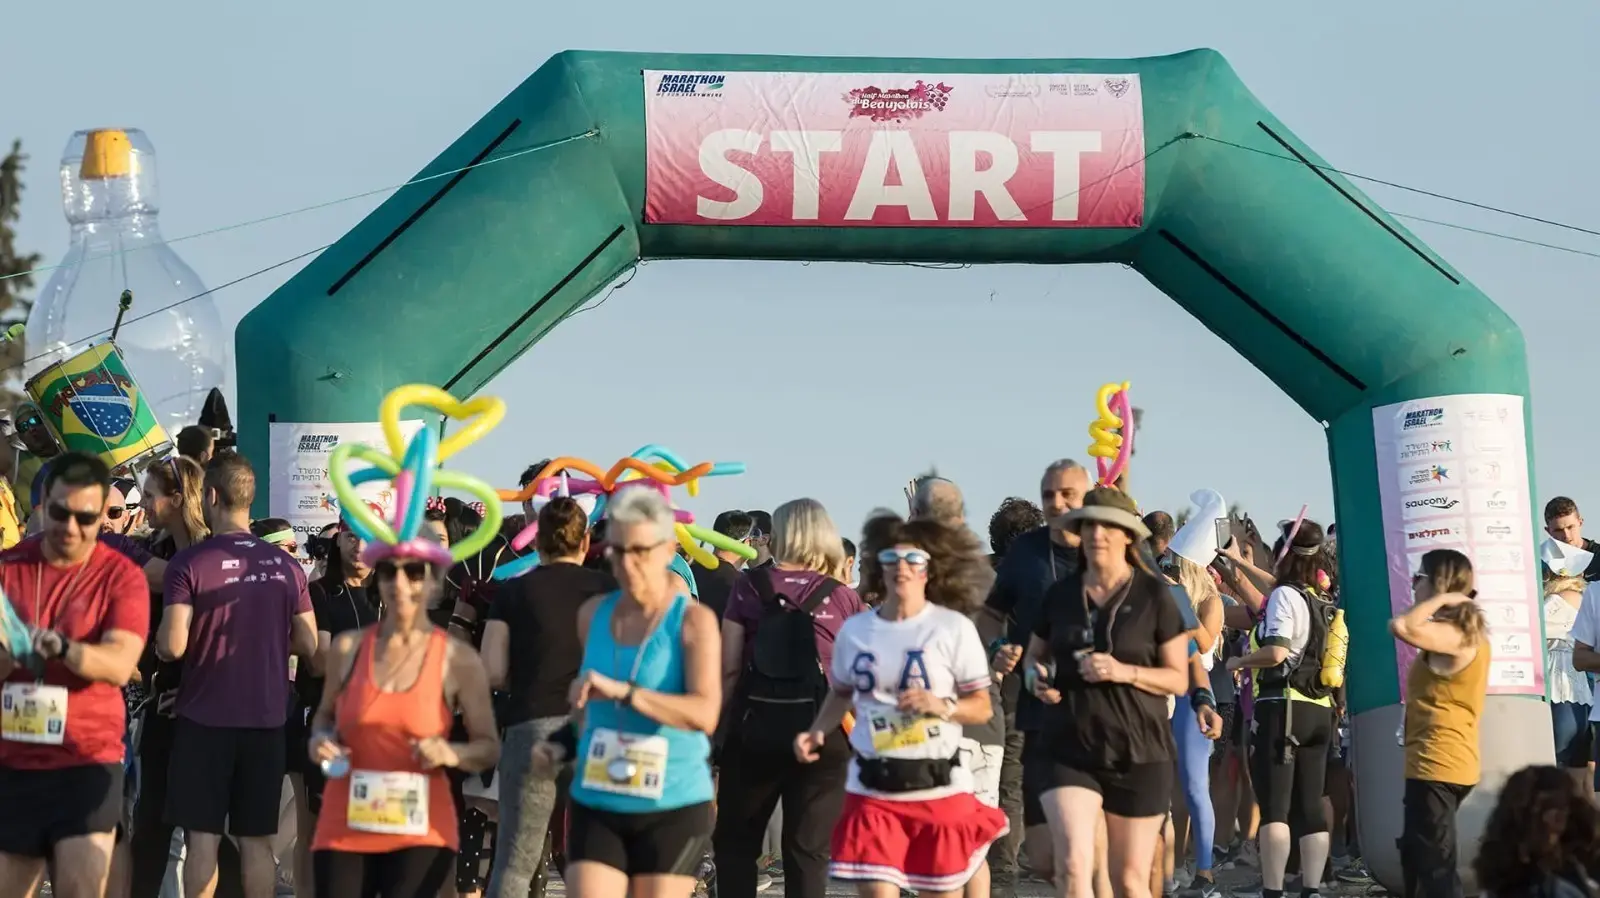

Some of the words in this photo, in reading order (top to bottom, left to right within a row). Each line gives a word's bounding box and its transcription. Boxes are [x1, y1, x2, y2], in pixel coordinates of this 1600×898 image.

[660, 74, 726, 85] MARATHON
[657, 83, 697, 93] ISRAEL
[861, 98, 930, 112] Beaujolais
[696, 129, 1102, 221] START
[1405, 407, 1444, 419] MARATHON
[1403, 416, 1427, 427] ISRAEL
[300, 434, 339, 443] MARATHON
[297, 442, 321, 450] ISRAEL
[1405, 497, 1447, 508] saucony
[292, 525, 322, 533] sauco
[852, 652, 876, 692] S
[899, 650, 931, 690] A
